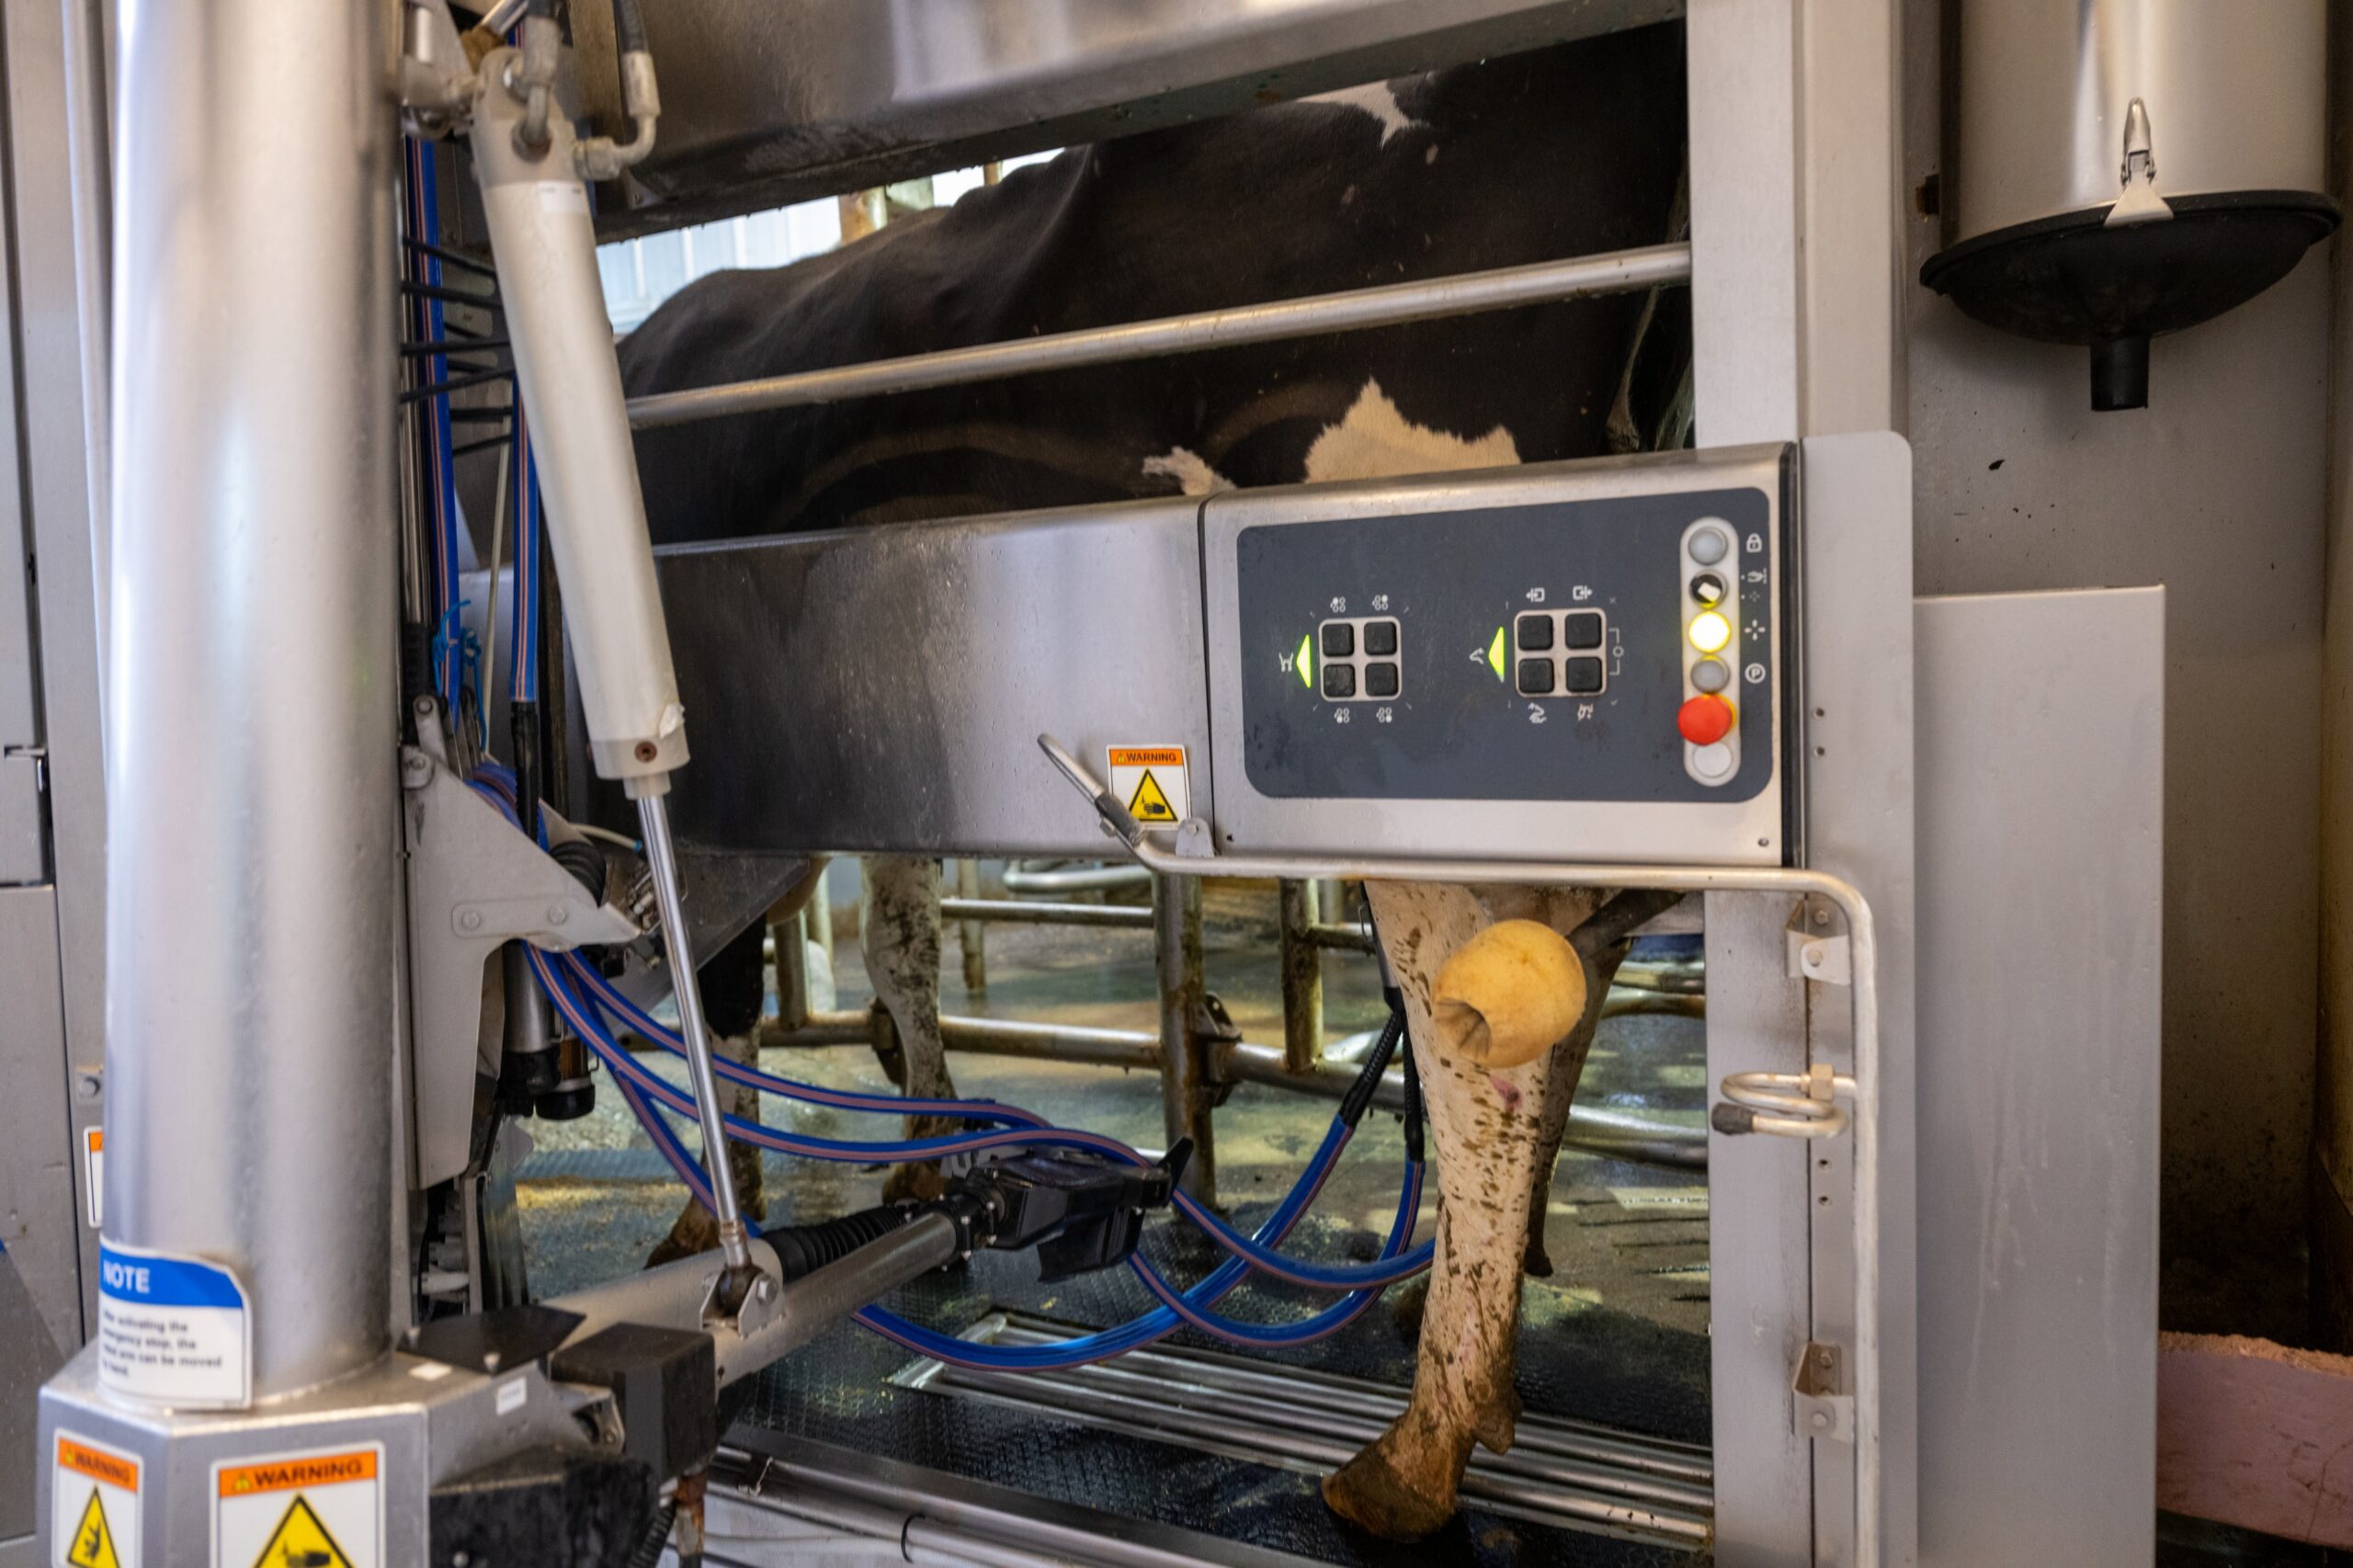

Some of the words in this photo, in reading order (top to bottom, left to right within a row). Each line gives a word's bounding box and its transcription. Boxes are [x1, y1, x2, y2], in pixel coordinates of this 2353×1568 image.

[1127, 752, 1176, 763] WARNING
[103, 1259, 150, 1294] NOTE
[169, 1322, 188, 1332] the
[176, 1339, 196, 1349] the
[179, 1356, 222, 1367] moved
[74, 1452, 130, 1483] WARNING
[255, 1460, 362, 1487] WARNING
